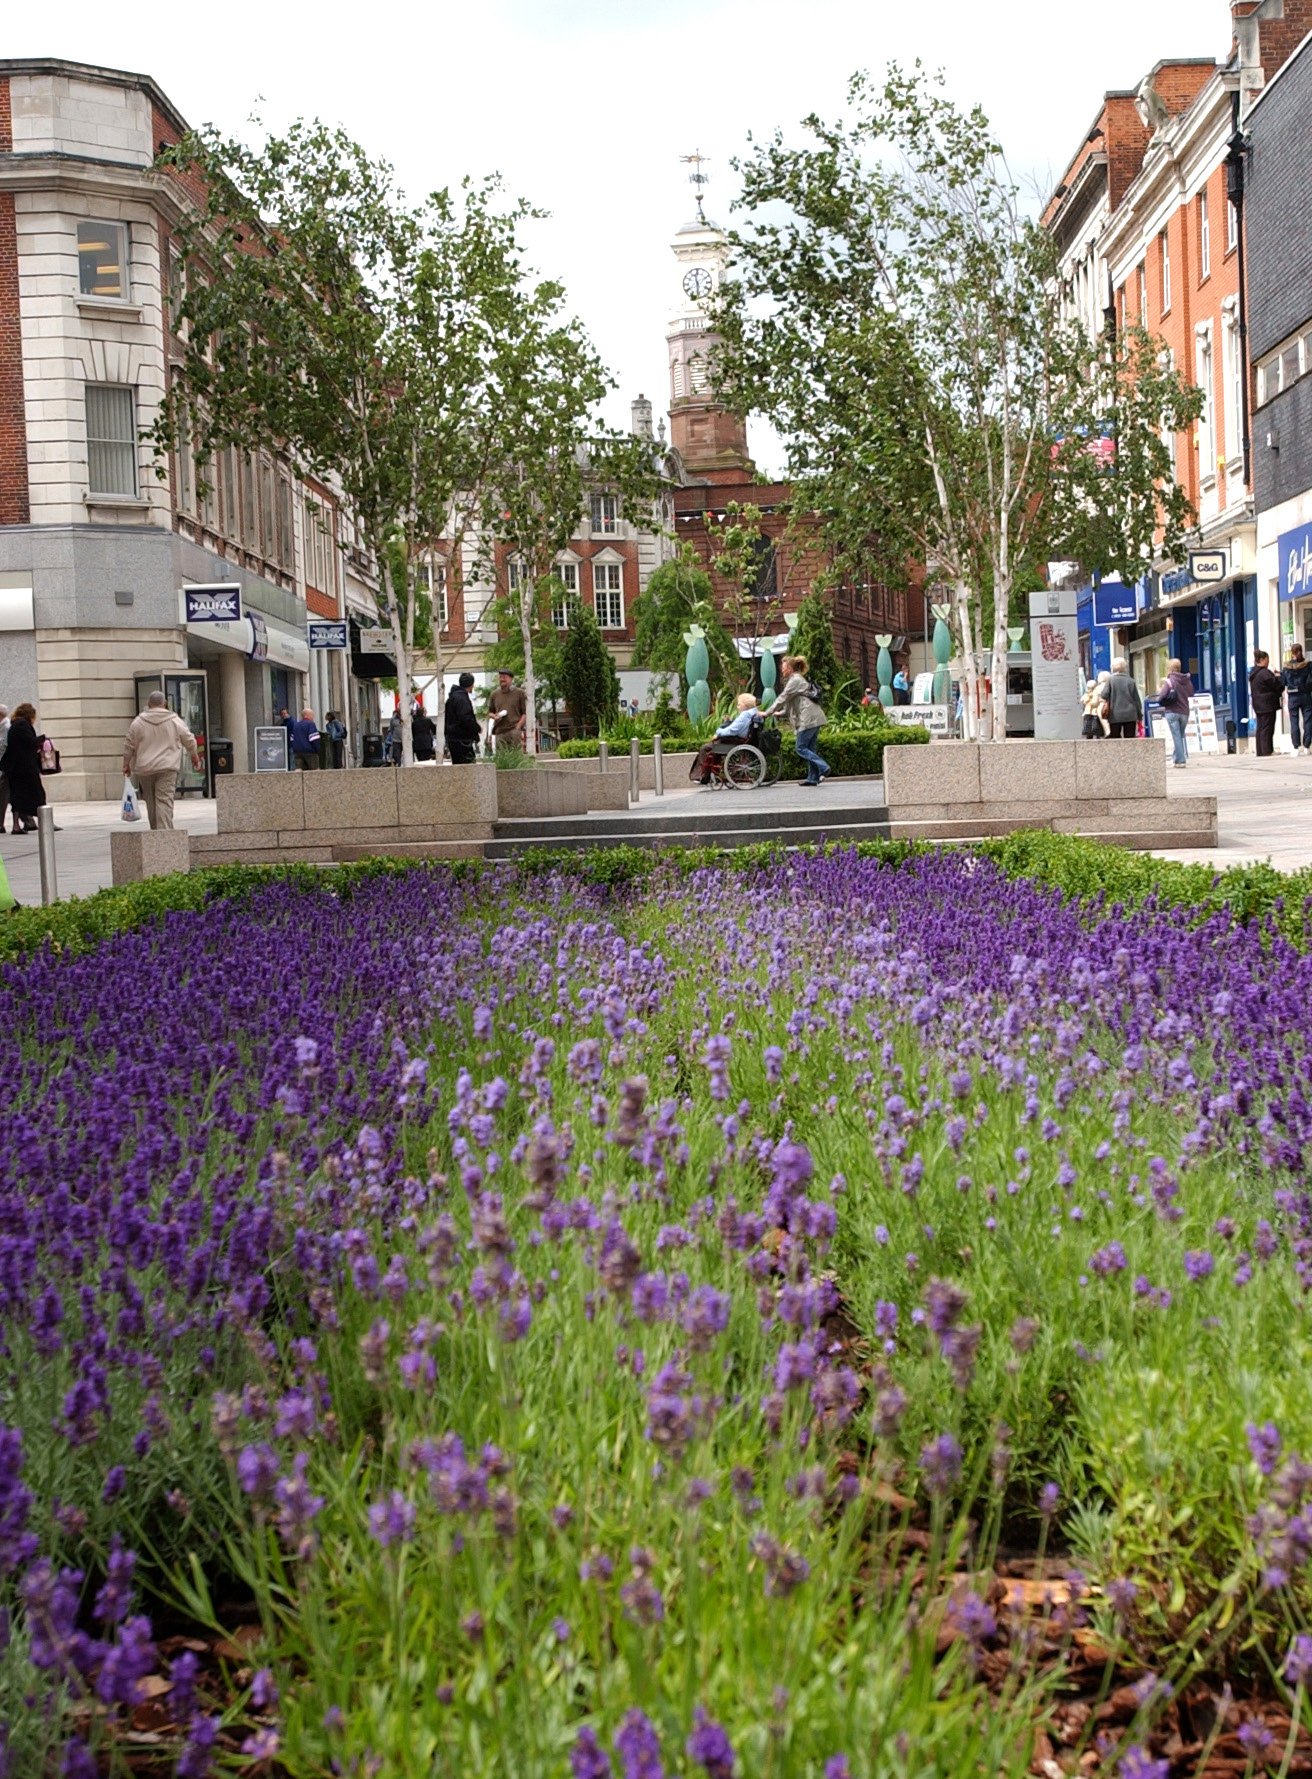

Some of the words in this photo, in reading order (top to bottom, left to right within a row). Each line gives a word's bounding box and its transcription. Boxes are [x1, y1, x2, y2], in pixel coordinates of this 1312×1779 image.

[1196, 563, 1219, 572] C&G
[189, 600, 237, 611] HALIFAX
[311, 632, 345, 640] HALIFAX
